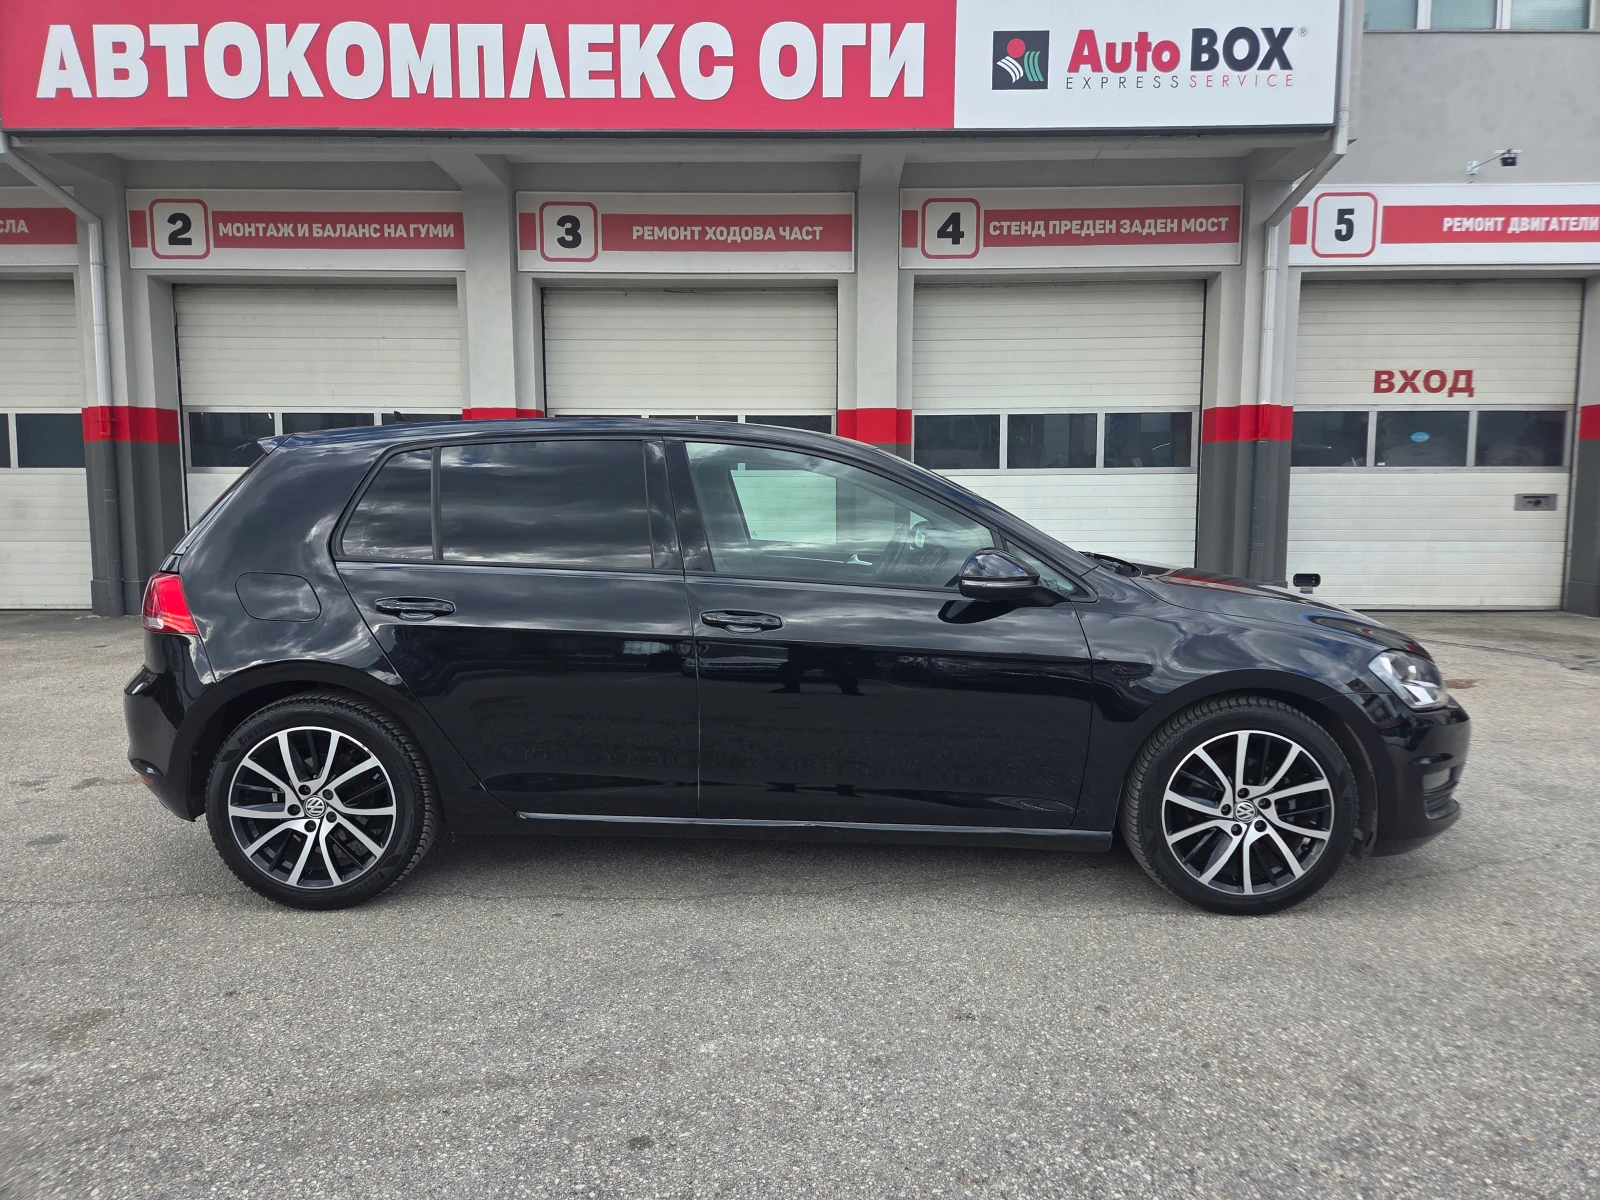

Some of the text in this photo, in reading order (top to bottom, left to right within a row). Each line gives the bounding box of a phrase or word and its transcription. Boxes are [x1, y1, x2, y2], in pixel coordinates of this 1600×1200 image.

[36, 21, 925, 100] АВТОКОМПЛЕКС ОГИ
[1067, 29, 1181, 73] Auto
[1066, 73, 1294, 90] EXPRESS SERVICE
[167, 212, 192, 246] 2
[218, 222, 455, 238] МОНТАЖ И БАЛАНС НА ГУМИ
[556, 214, 583, 249] 3
[632, 226, 823, 243] РЕМОНТ ХОДОВА ЧАСТ
[936, 212, 965, 245] 4
[989, 217, 1229, 237] СТЕНД ПРЕДЕН ЗАДЕН МОСТ
[1334, 208, 1355, 242] 5
[1442, 216, 1600, 234] РЕМОНТ ДВИГАТЕЛИ
[1373, 369, 1475, 398] ВХОД
